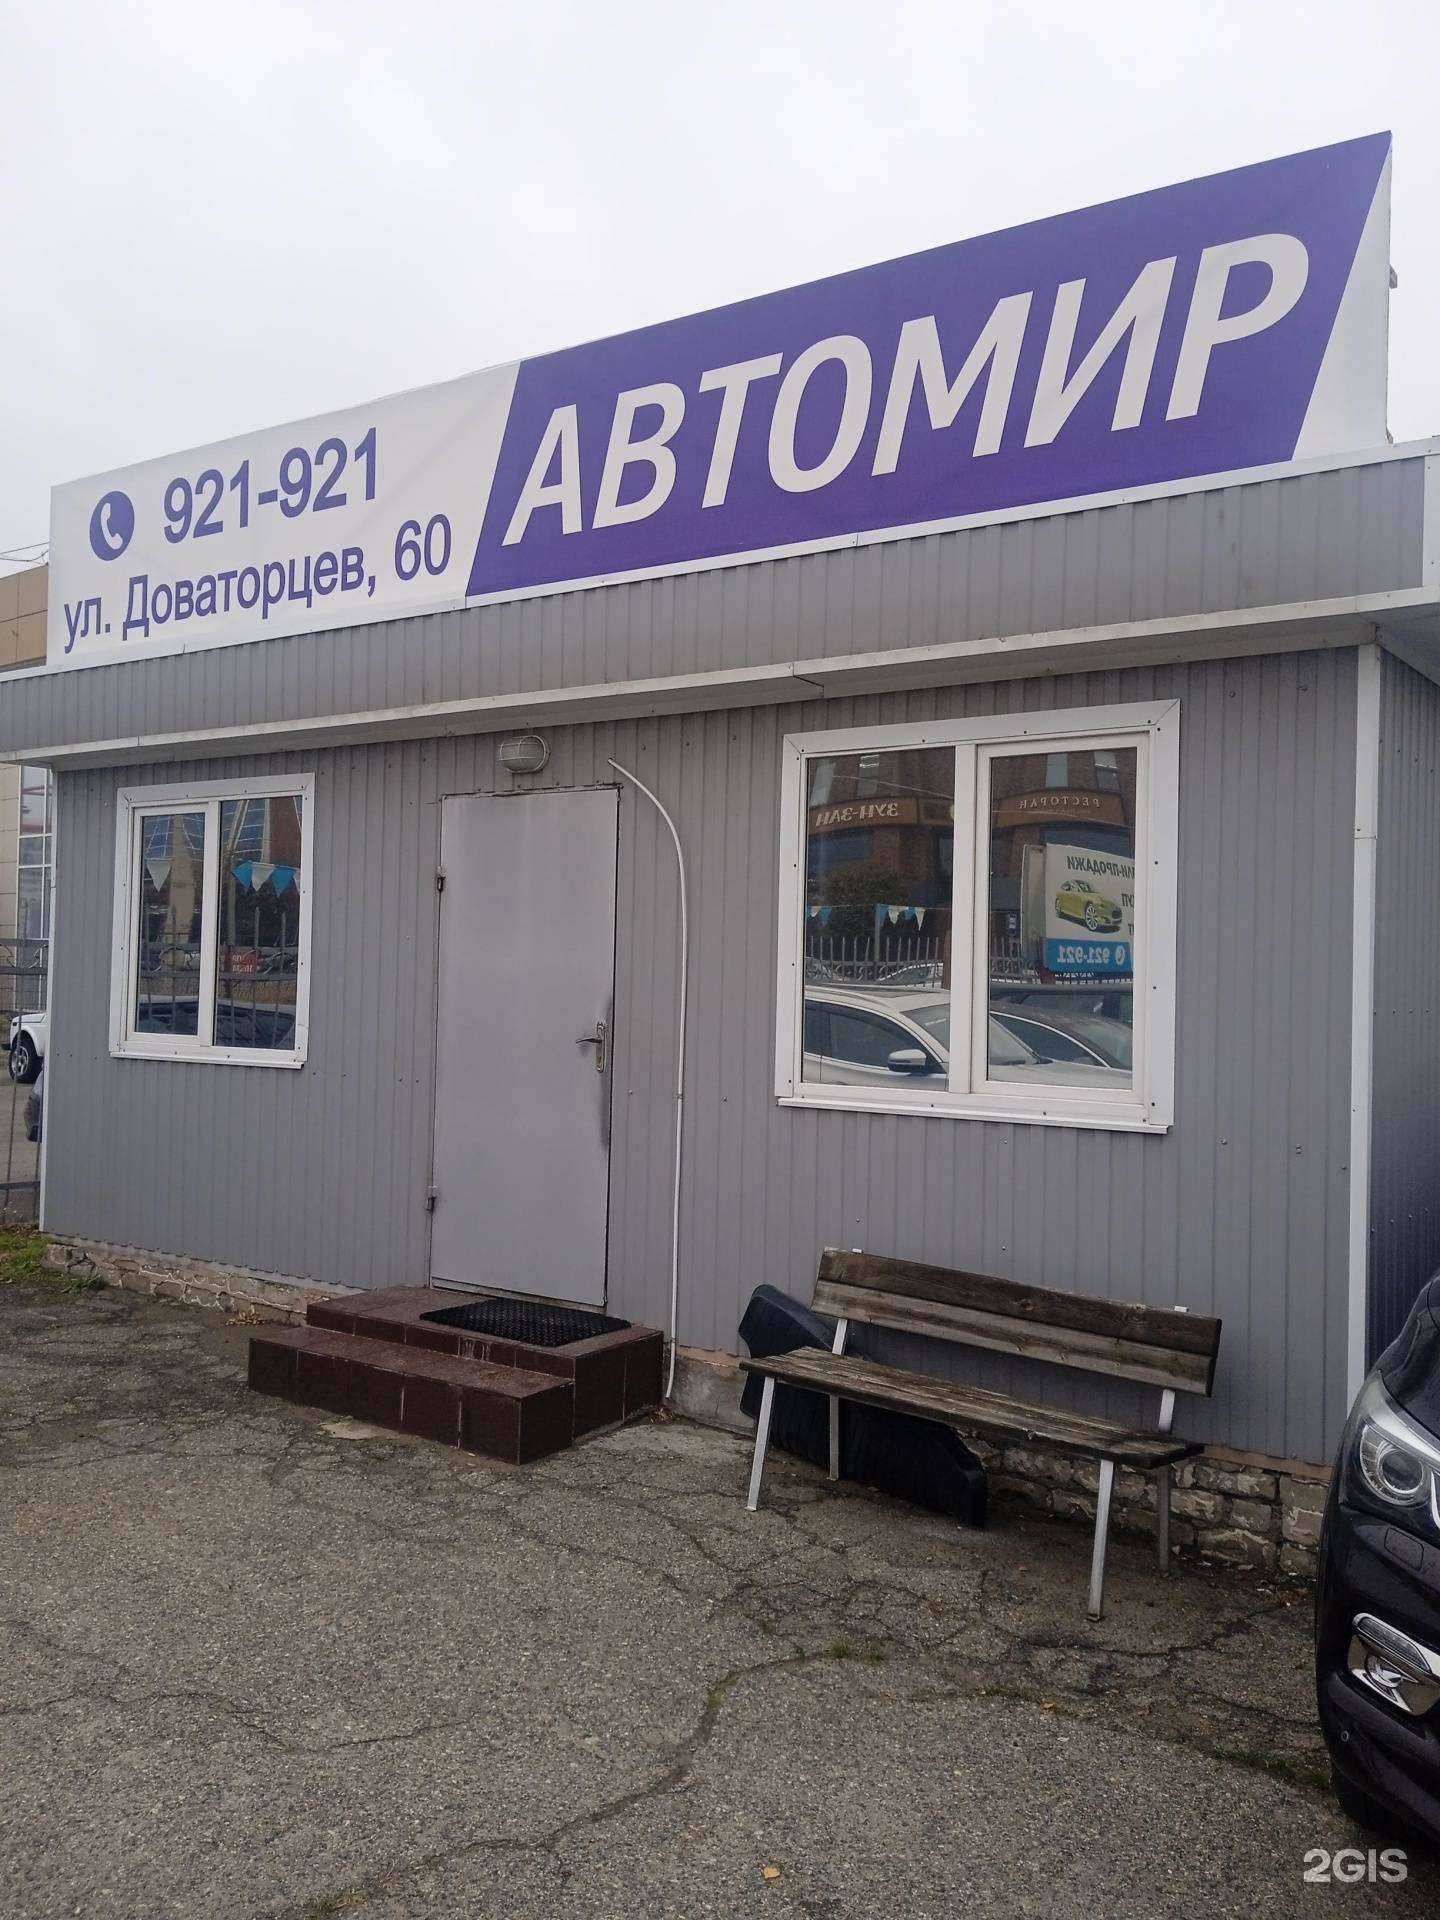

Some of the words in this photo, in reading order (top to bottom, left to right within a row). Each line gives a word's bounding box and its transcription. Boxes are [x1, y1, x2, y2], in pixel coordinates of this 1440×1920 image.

[501, 233, 1310, 547] АВТОМИР
[163, 427, 378, 544] 921-921
[63, 596, 112, 653] ул.
[122, 546, 377, 642] Доваторцев,
[394, 513, 453, 581] 60
